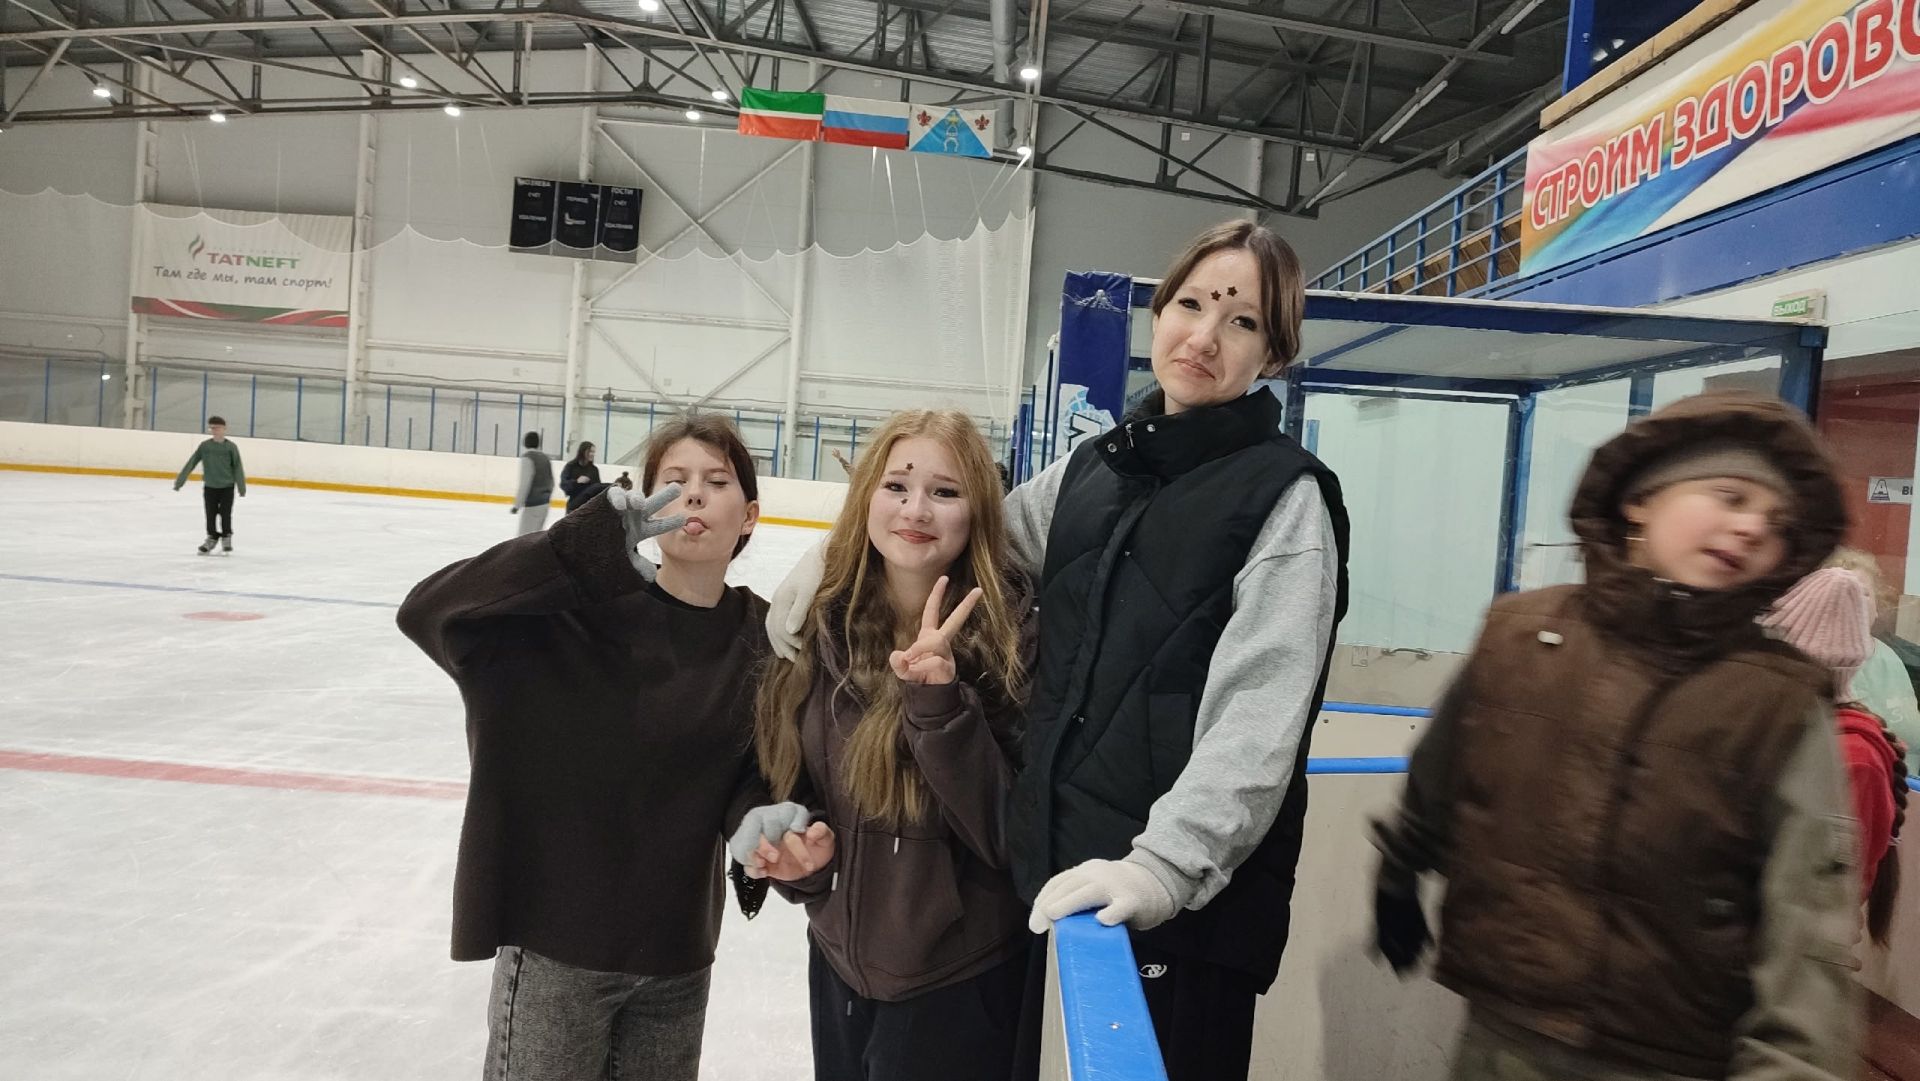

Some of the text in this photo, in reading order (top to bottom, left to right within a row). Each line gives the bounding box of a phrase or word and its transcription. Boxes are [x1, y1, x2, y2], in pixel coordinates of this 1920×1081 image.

[1531, 112, 1664, 230] СТРОИМ
[207, 252, 300, 270] TATNEFT
[153, 265, 333, 291] Там где мы, там спорт!
